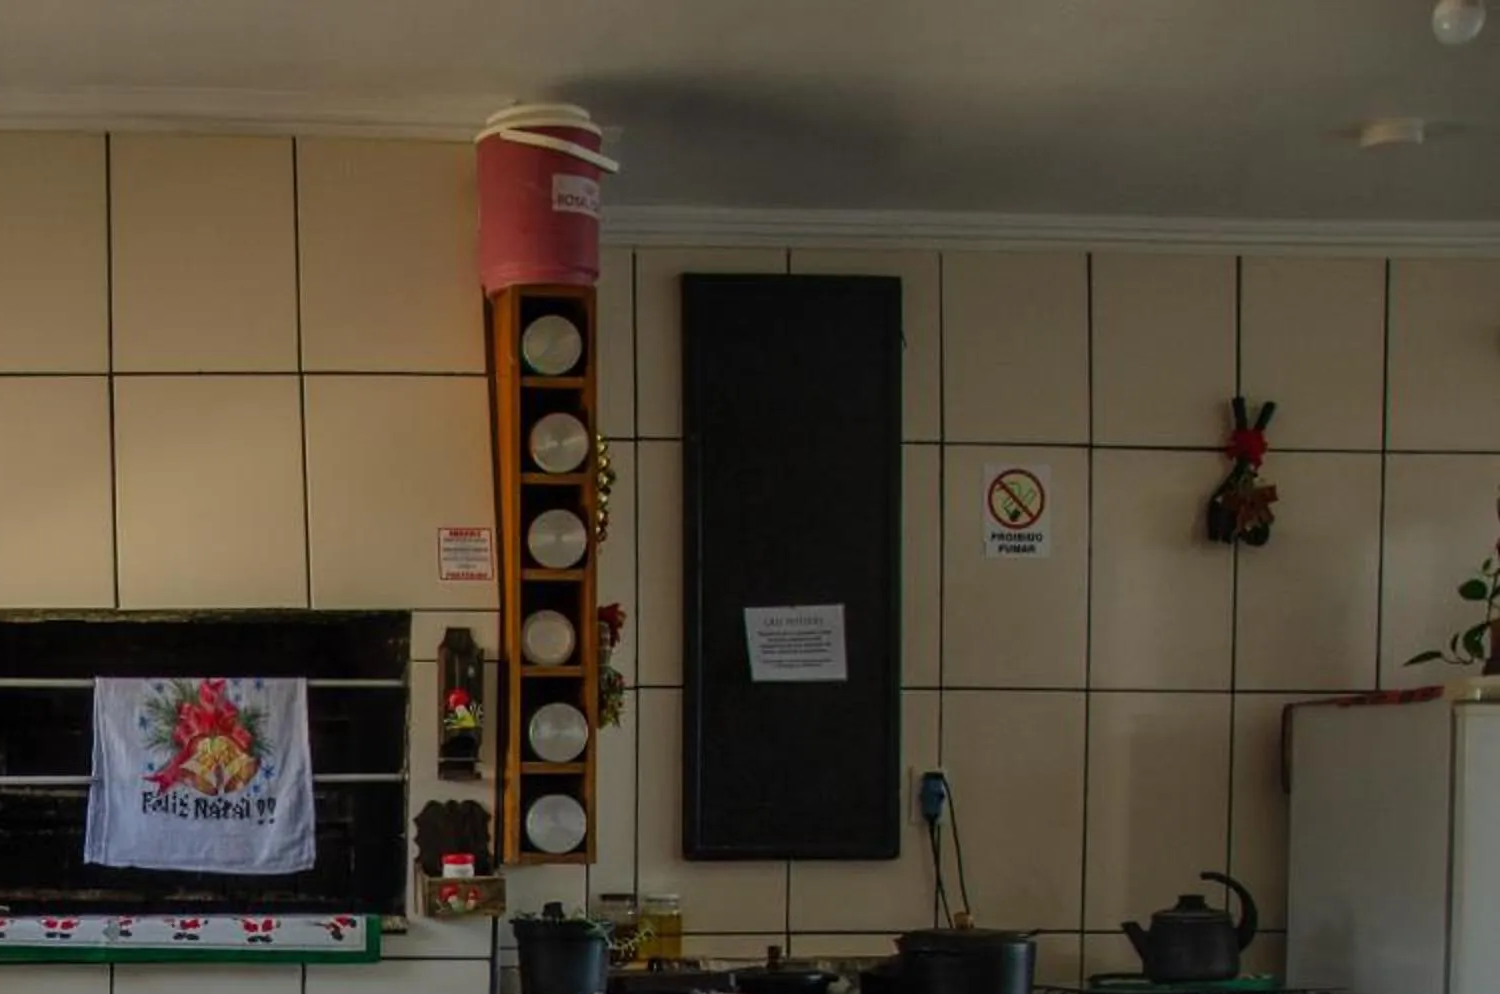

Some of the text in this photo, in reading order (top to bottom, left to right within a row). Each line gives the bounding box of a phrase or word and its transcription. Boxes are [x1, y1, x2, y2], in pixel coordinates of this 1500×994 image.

[991, 531, 1043, 542] PROIBIDO
[998, 543, 1035, 553] FUMAR
[142, 791, 190, 818] Feliz
